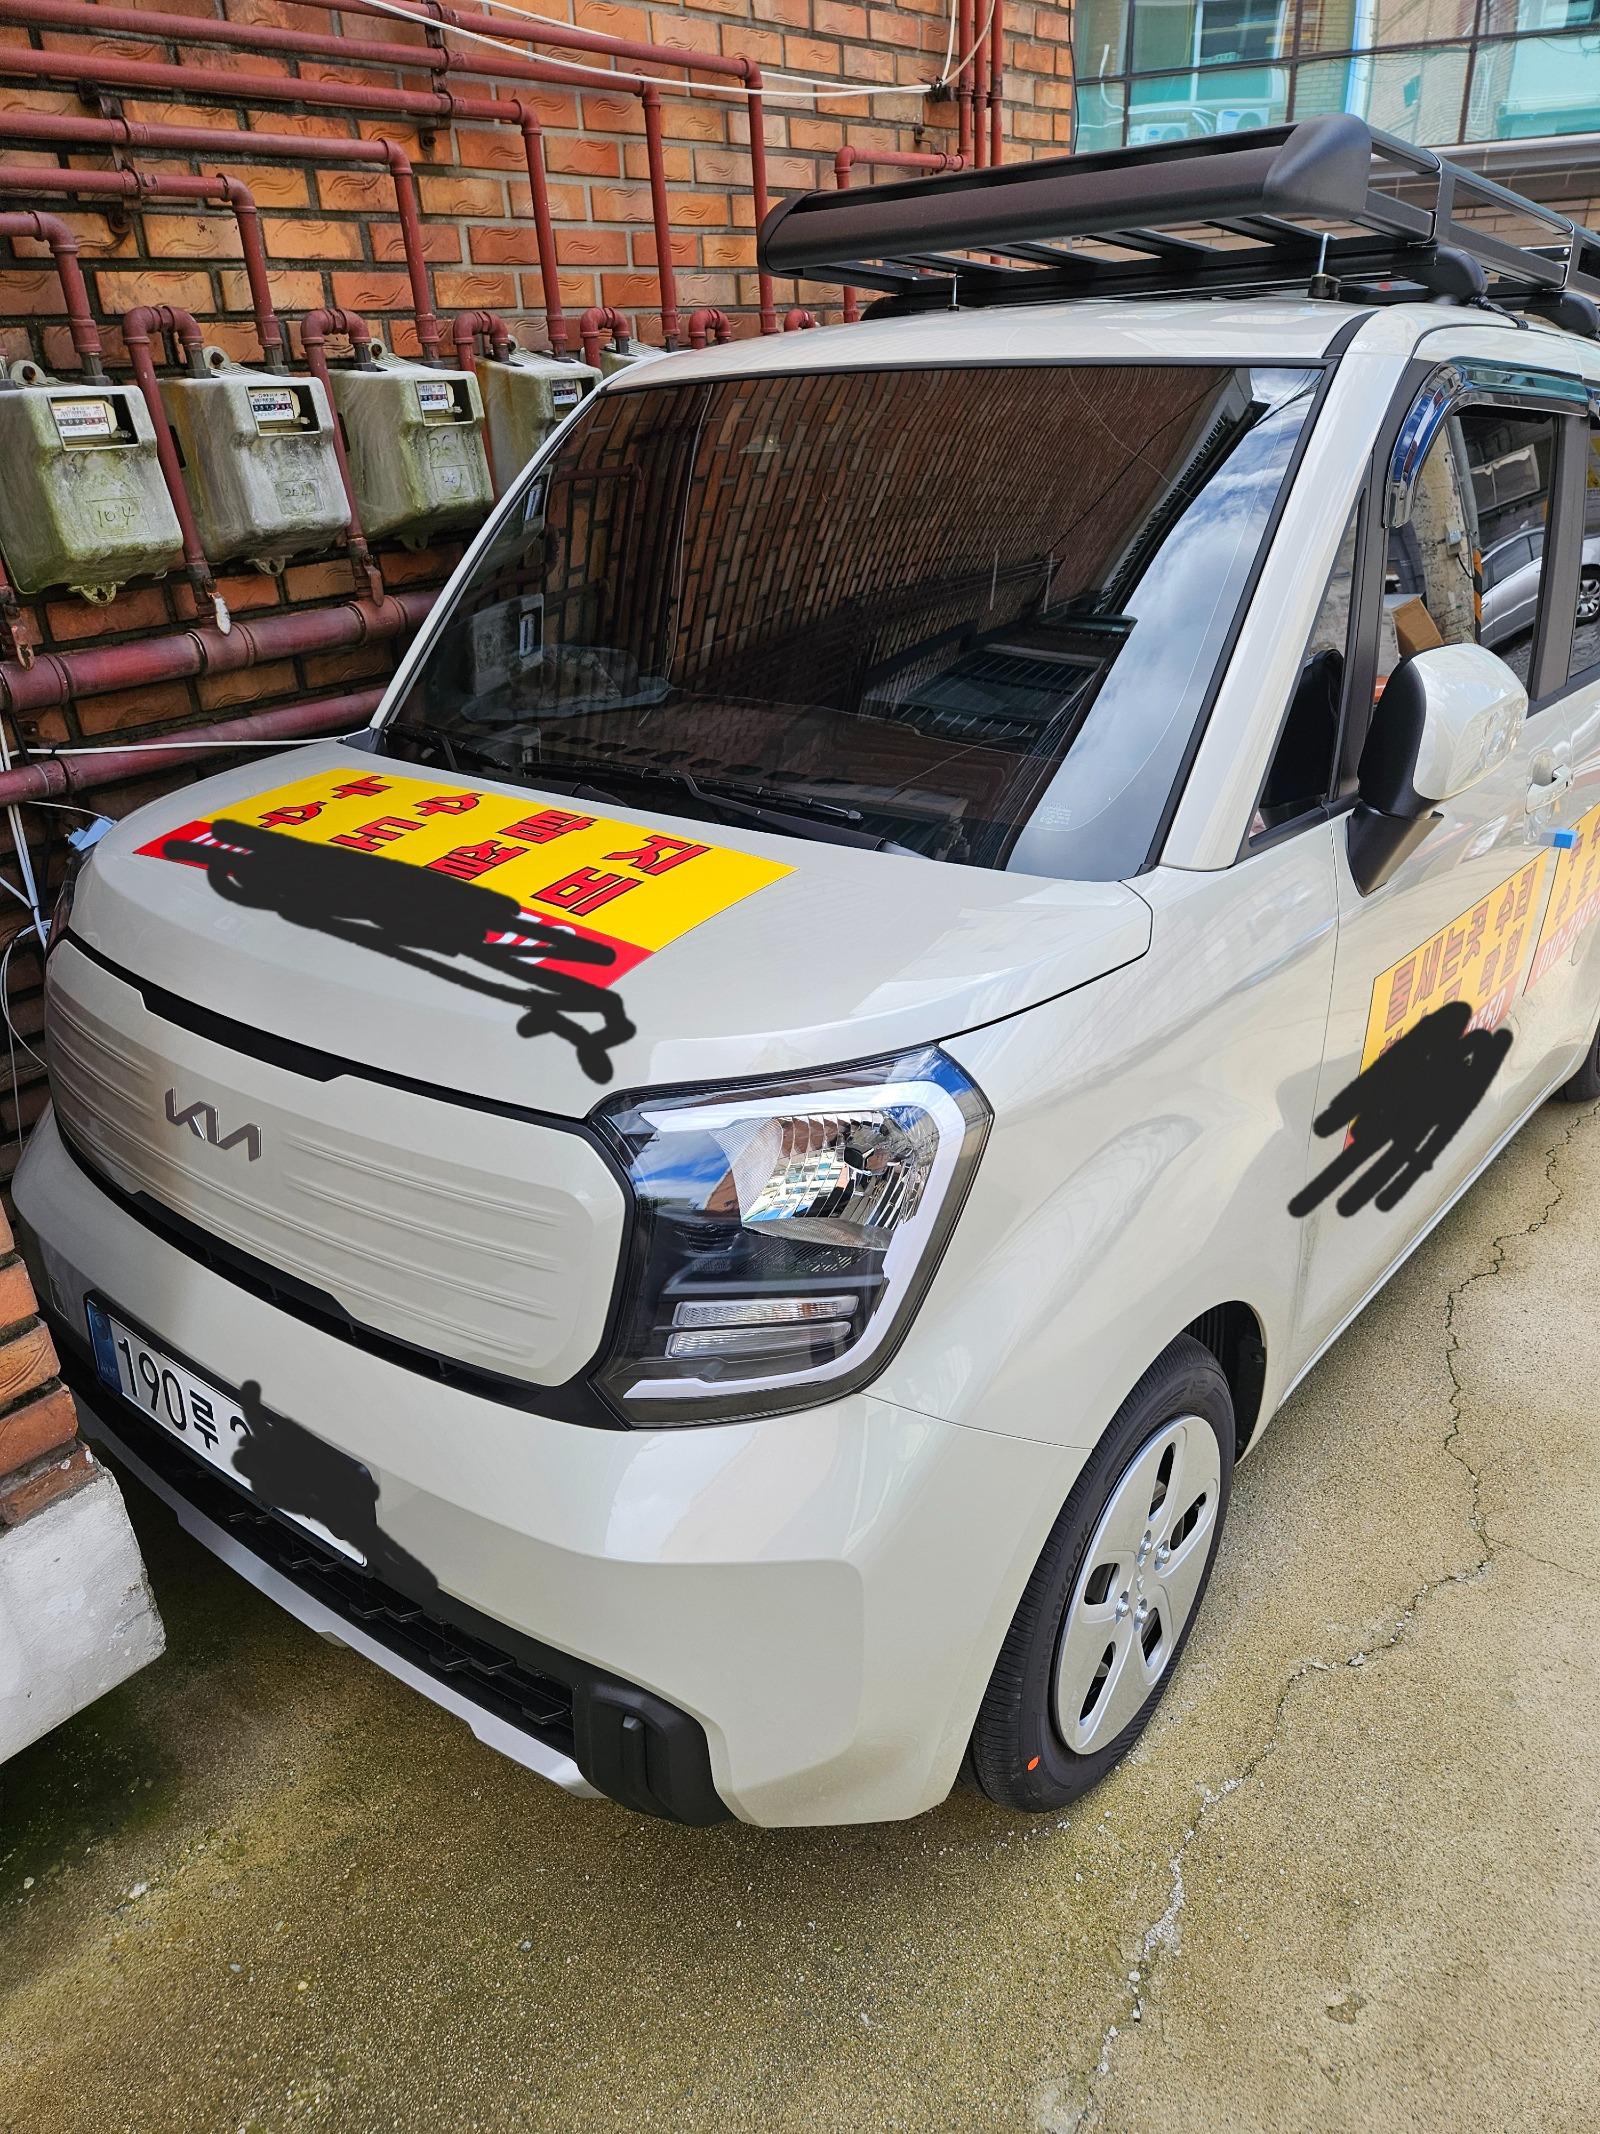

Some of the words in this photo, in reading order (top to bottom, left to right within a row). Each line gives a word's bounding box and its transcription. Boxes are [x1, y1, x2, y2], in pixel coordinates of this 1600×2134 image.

[257, 800, 644, 917] 수도설비
[331, 775, 713, 876] 누수탐지
[1384, 900, 1490, 1033] 물새는곳
[1495, 861, 1538, 937] 수리
[165, 1088, 261, 1161] KIA
